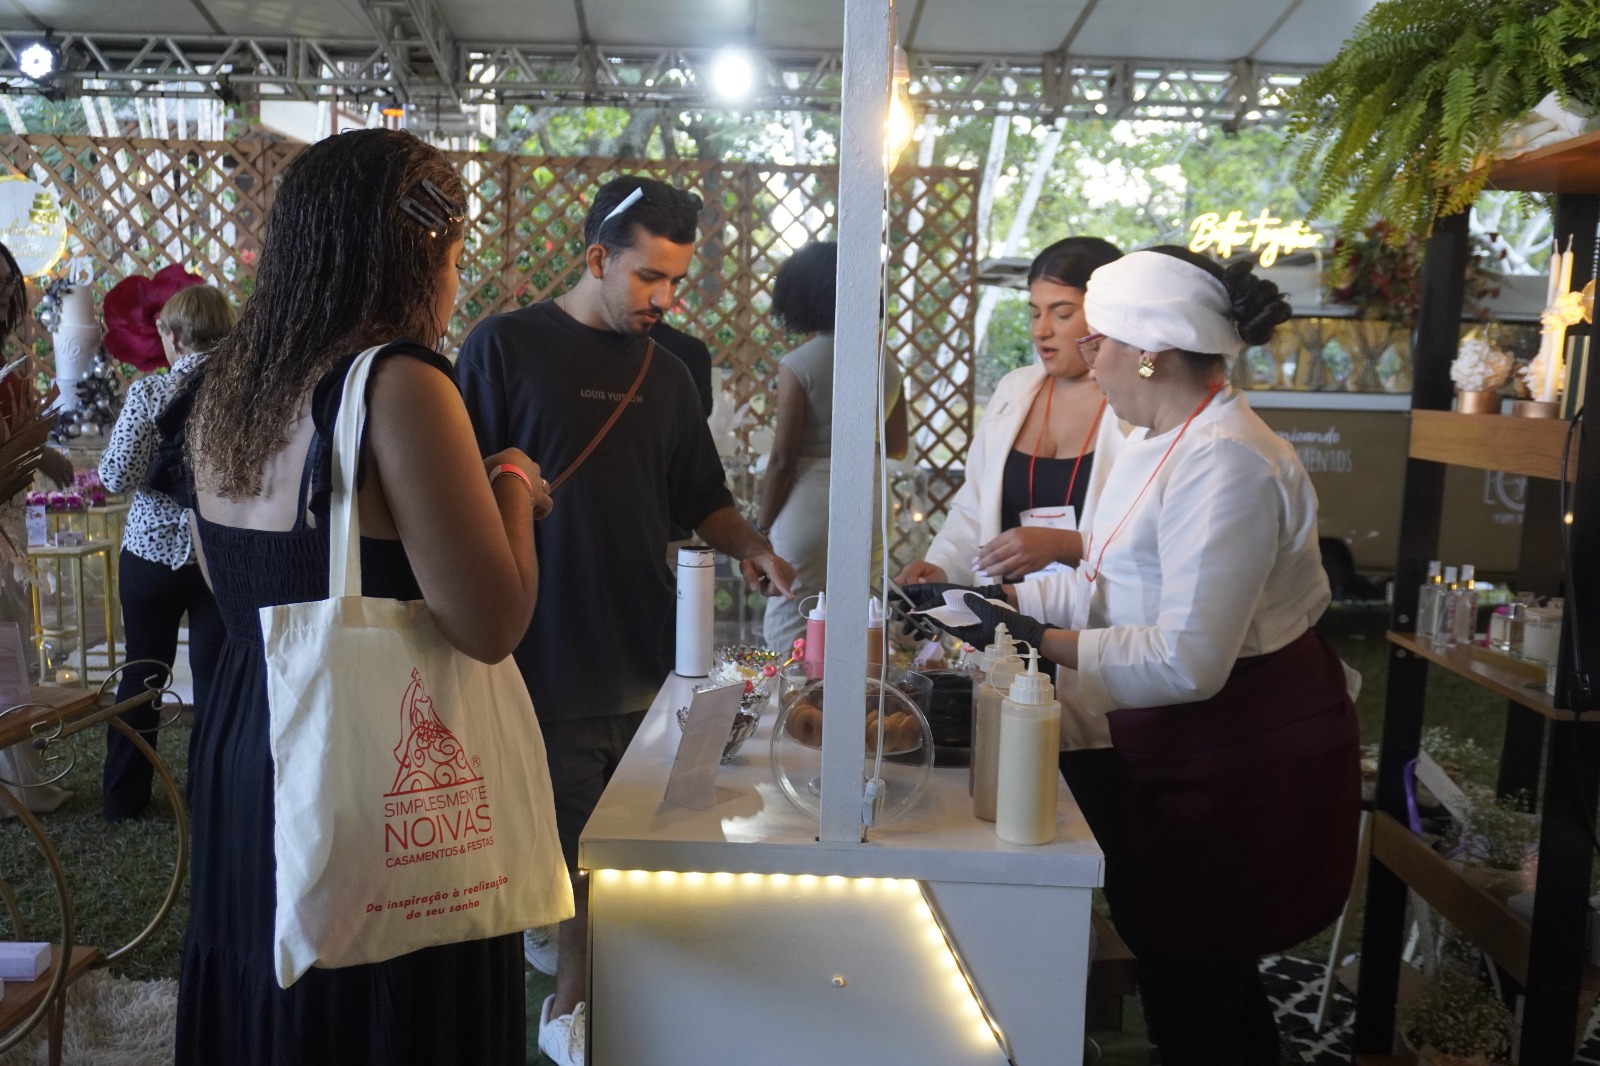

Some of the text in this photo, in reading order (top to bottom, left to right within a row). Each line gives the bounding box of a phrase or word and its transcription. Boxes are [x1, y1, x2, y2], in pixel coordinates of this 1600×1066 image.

[580, 388, 644, 403] LOUIS VUITON
[384, 785, 488, 818] SIMPLESMENTE
[385, 804, 492, 853] NOIVAS
[385, 836, 494, 868] CASAMENTOS & FESTAS
[366, 875, 508, 913] Da inspiração à realização
[406, 899, 480, 920] do seu sonho
